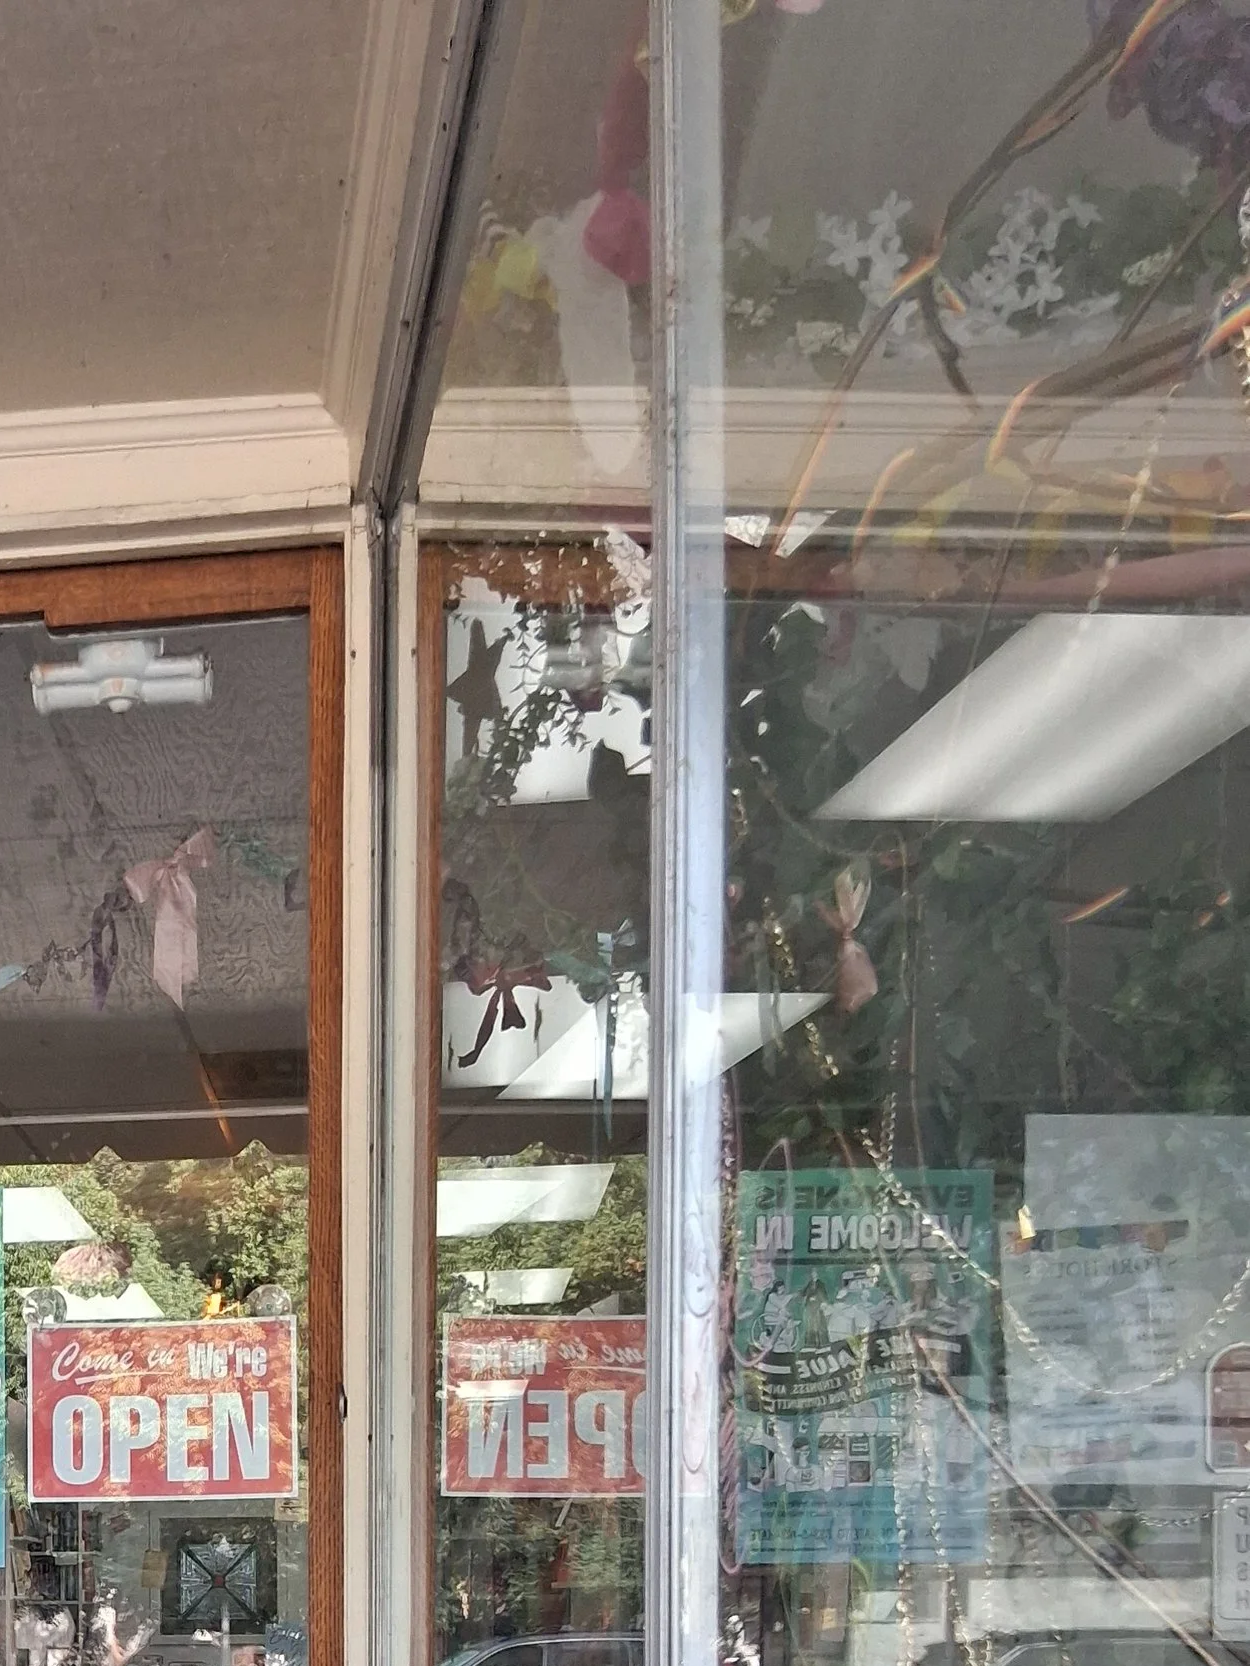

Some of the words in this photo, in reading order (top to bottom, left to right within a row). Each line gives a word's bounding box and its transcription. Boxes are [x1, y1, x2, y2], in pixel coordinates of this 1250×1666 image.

[52, 1341, 137, 1381] Come
[147, 1347, 176, 1368] in
[189, 1341, 268, 1380] We're
[52, 1390, 270, 1485] OPEN
